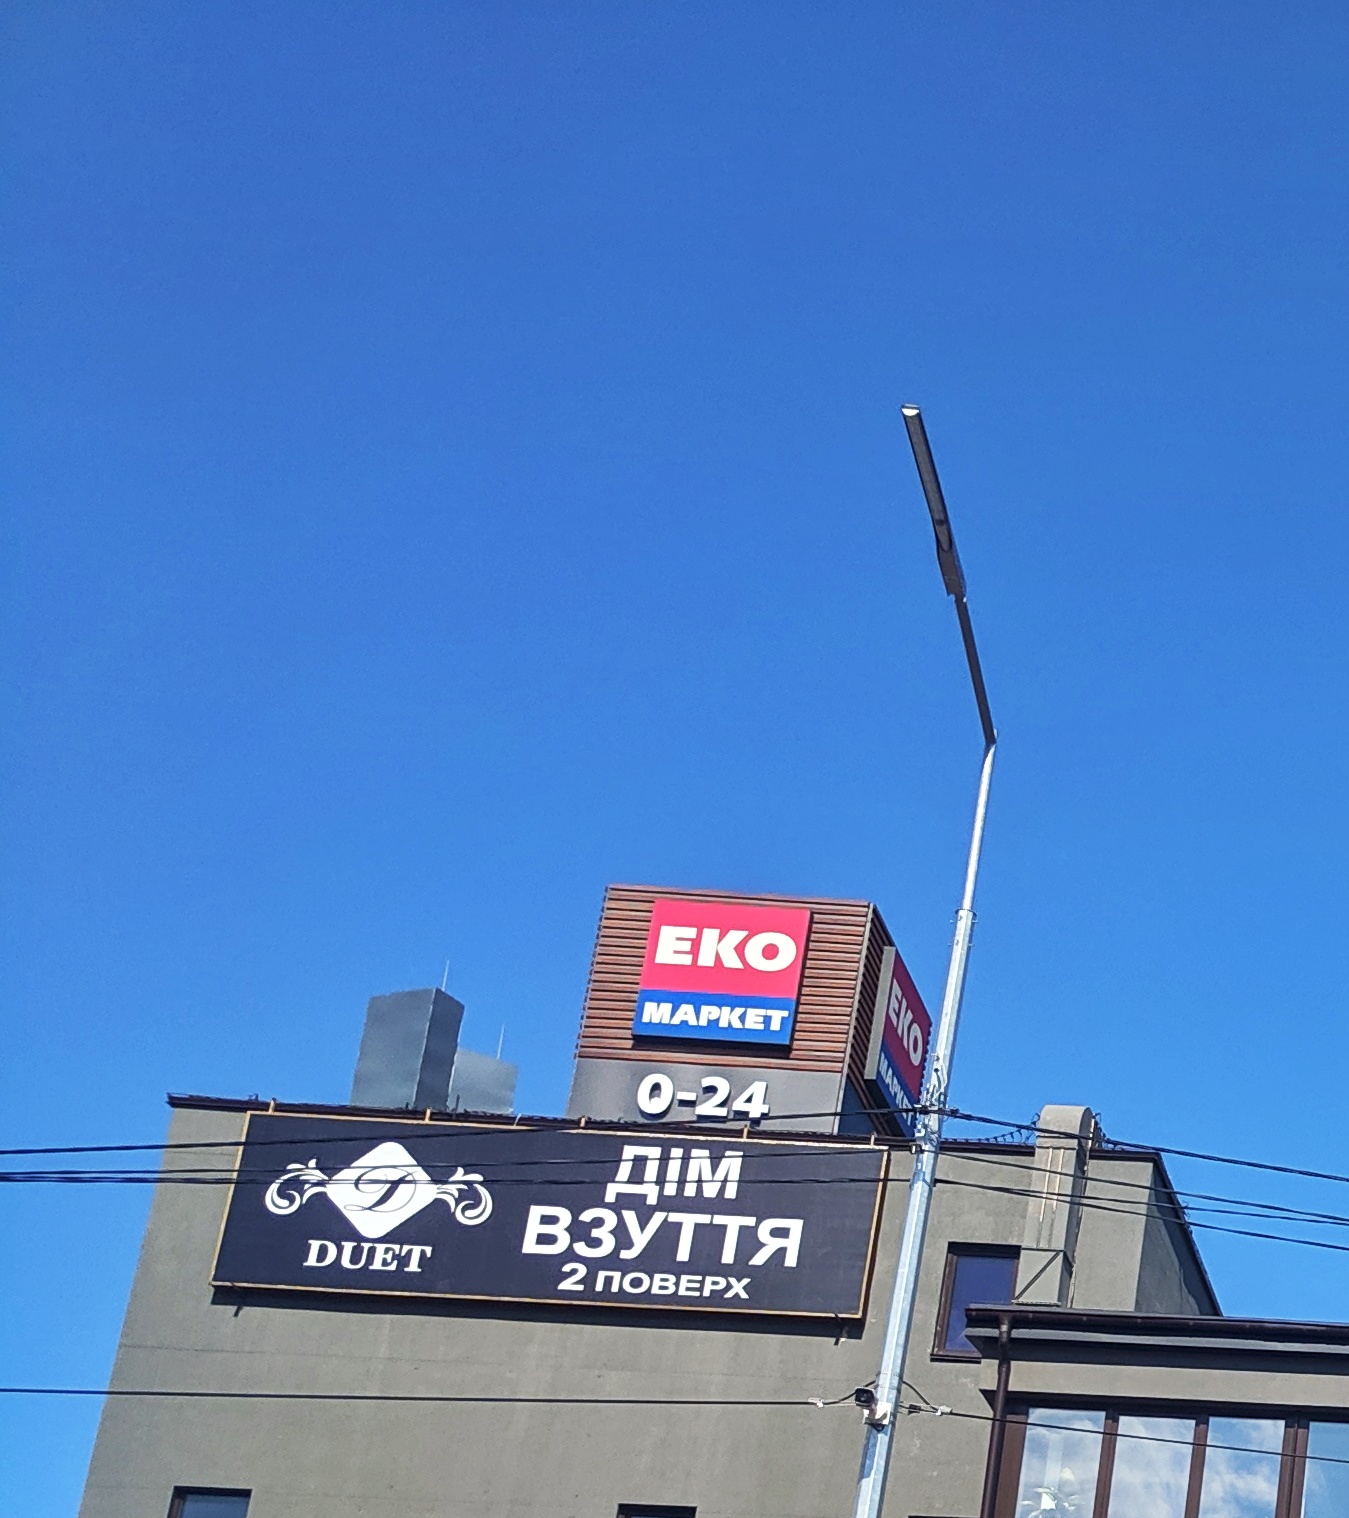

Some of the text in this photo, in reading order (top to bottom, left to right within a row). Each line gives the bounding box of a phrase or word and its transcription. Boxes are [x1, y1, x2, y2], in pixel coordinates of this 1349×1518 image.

[641, 1000, 789, 1033] МАРКЕТ
[636, 1073, 770, 1121] 0-24
[605, 1143, 743, 1204] ДІМ
[303, 1239, 432, 1273] DUET
[520, 1204, 804, 1268] ВЗУТТЯ
[557, 1262, 751, 1299] 2 ПОВЕРХ
